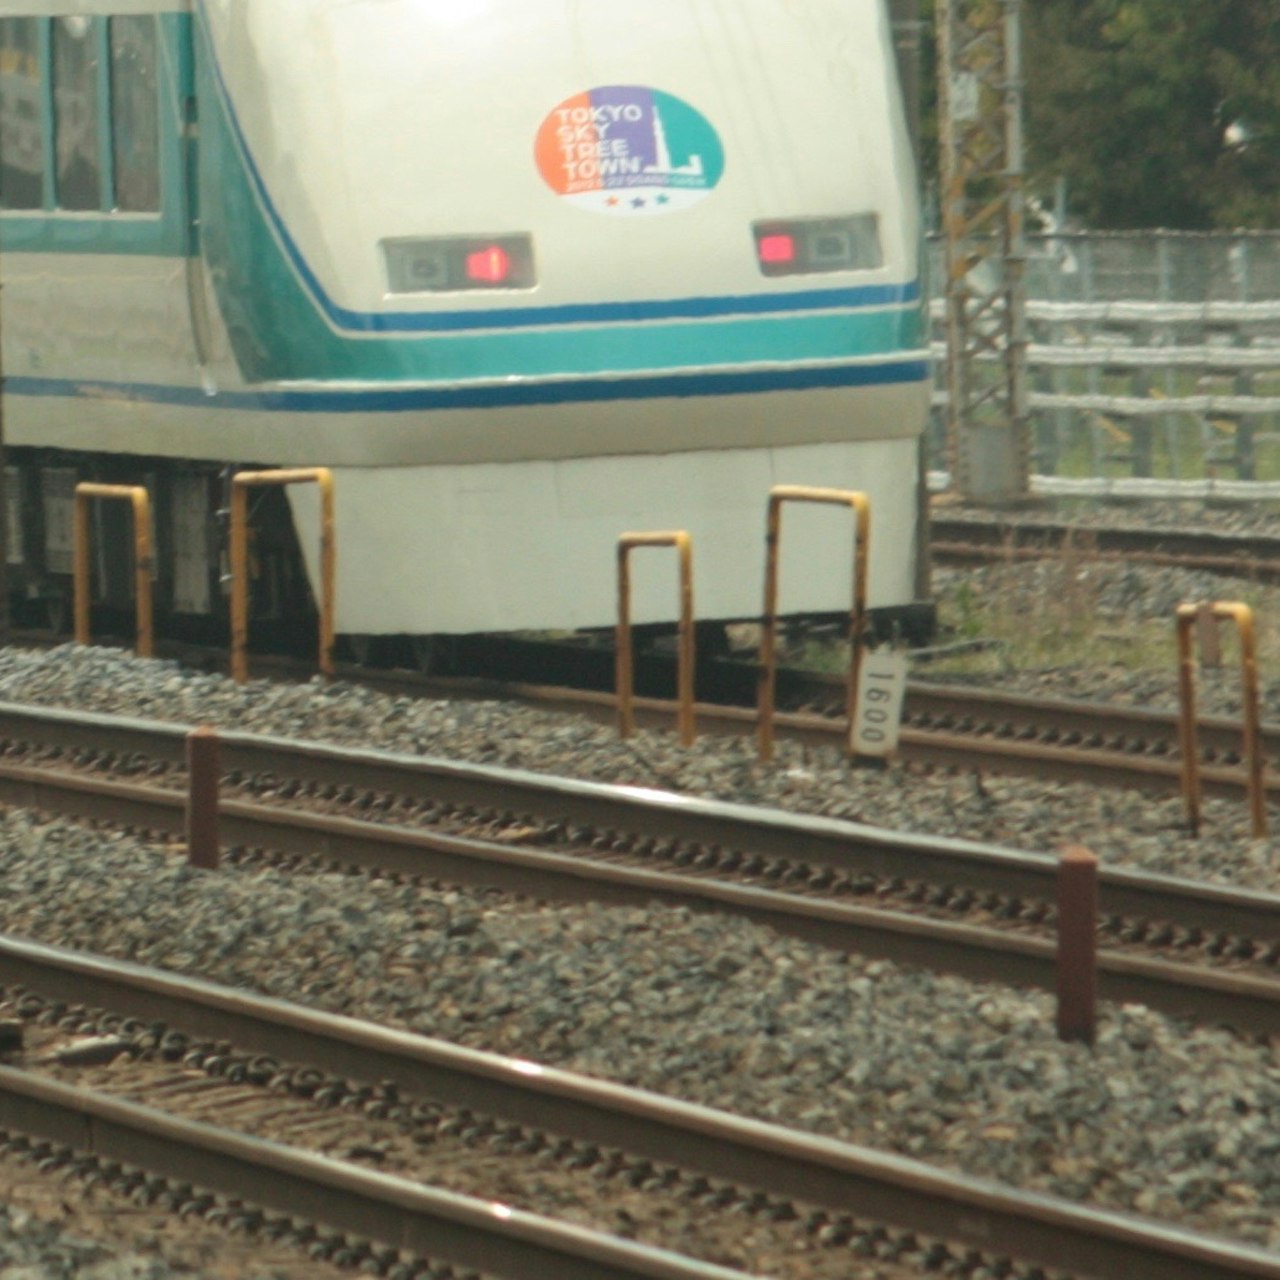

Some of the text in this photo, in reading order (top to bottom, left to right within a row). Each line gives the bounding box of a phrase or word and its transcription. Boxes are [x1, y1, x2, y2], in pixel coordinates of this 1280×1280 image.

[556, 104, 642, 124] TOKYO
[556, 122, 610, 144] SKY
[560, 138, 629, 160] TREE
[562, 156, 642, 181] TOWN
[861, 672, 896, 743] 1600
